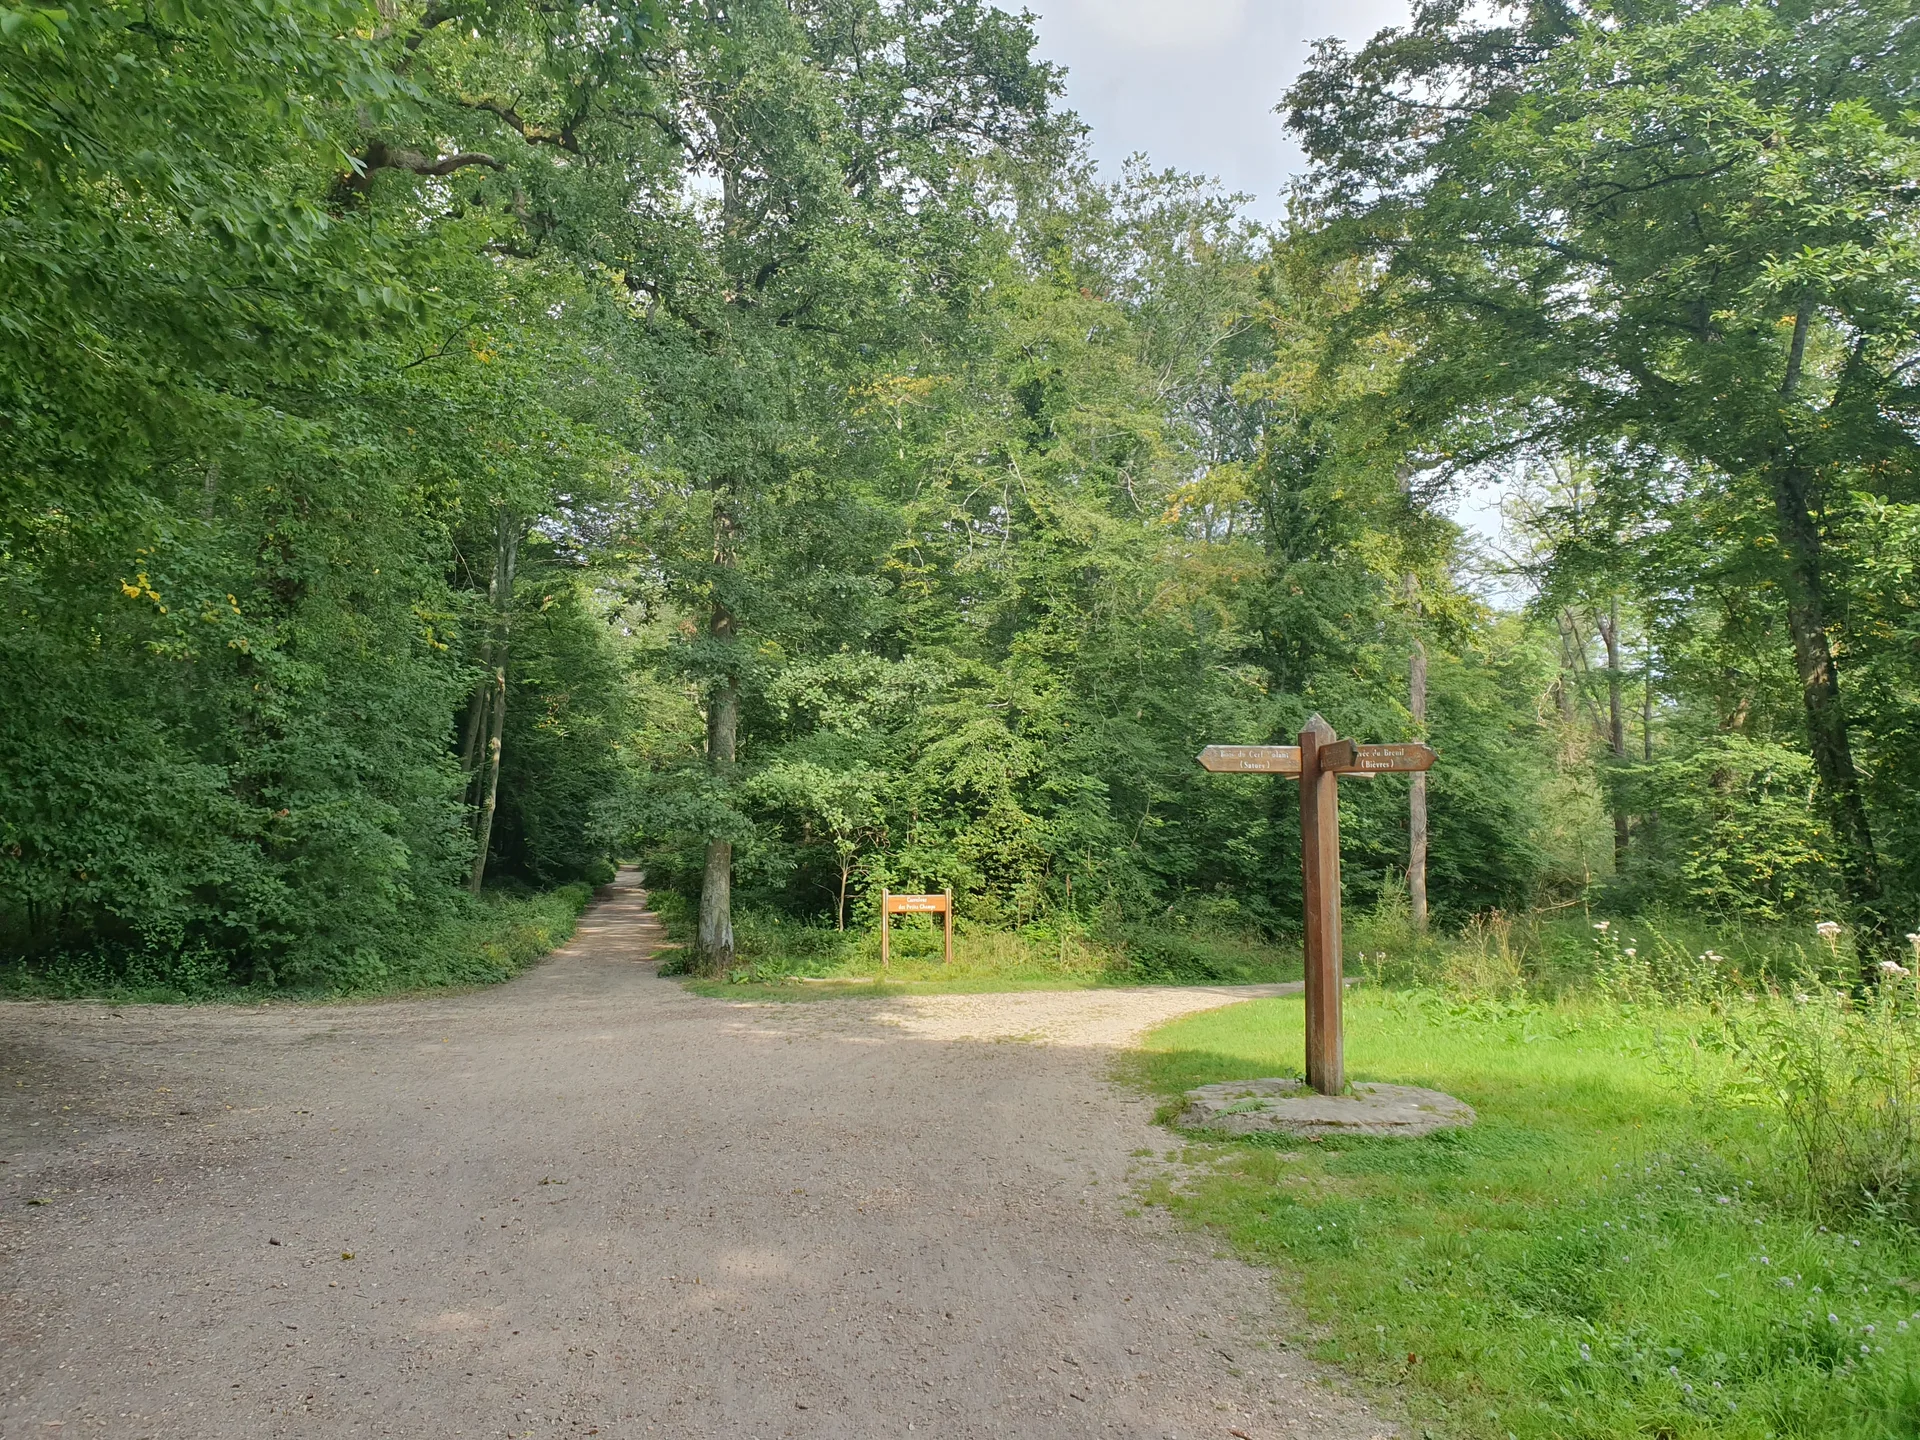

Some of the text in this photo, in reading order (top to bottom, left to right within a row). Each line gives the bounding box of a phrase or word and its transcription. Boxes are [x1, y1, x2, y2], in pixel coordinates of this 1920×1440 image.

[1249, 750, 1264, 758] Cerf
[1372, 748, 1381, 757] du
[1384, 748, 1405, 757] Breuil
[1361, 758, 1394, 769] (Bièvres)
